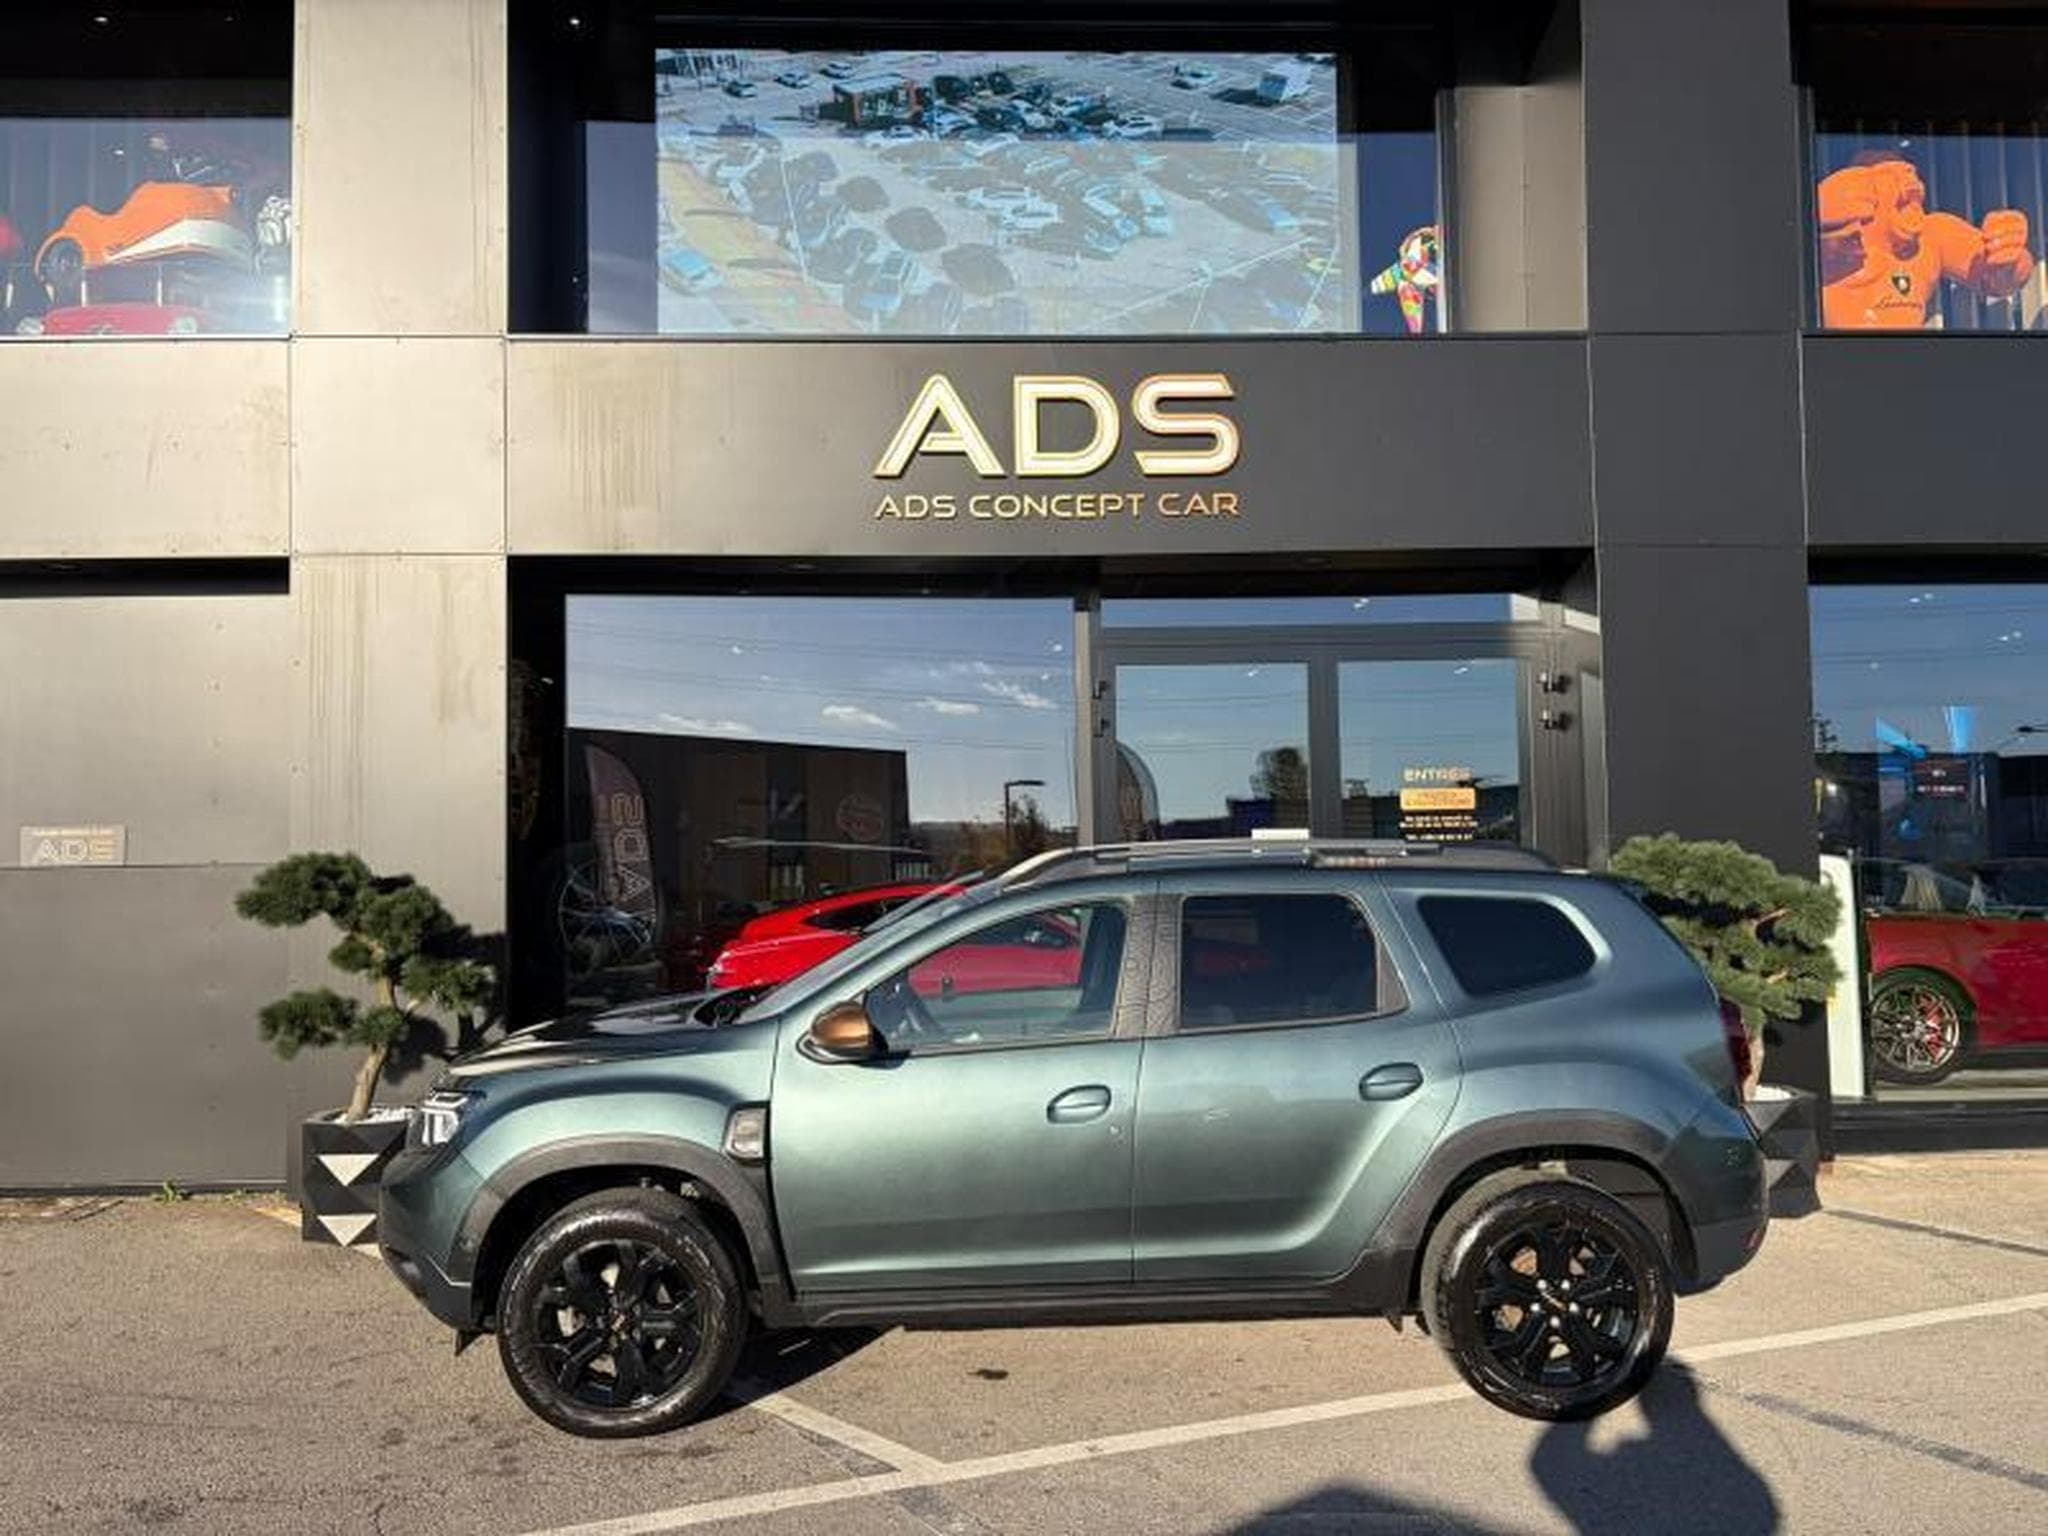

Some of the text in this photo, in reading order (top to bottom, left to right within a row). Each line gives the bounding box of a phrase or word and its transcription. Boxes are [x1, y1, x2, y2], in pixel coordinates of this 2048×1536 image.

[873, 373, 1240, 477] ADS
[875, 492, 1240, 519] ADS CONCEPT CAR
